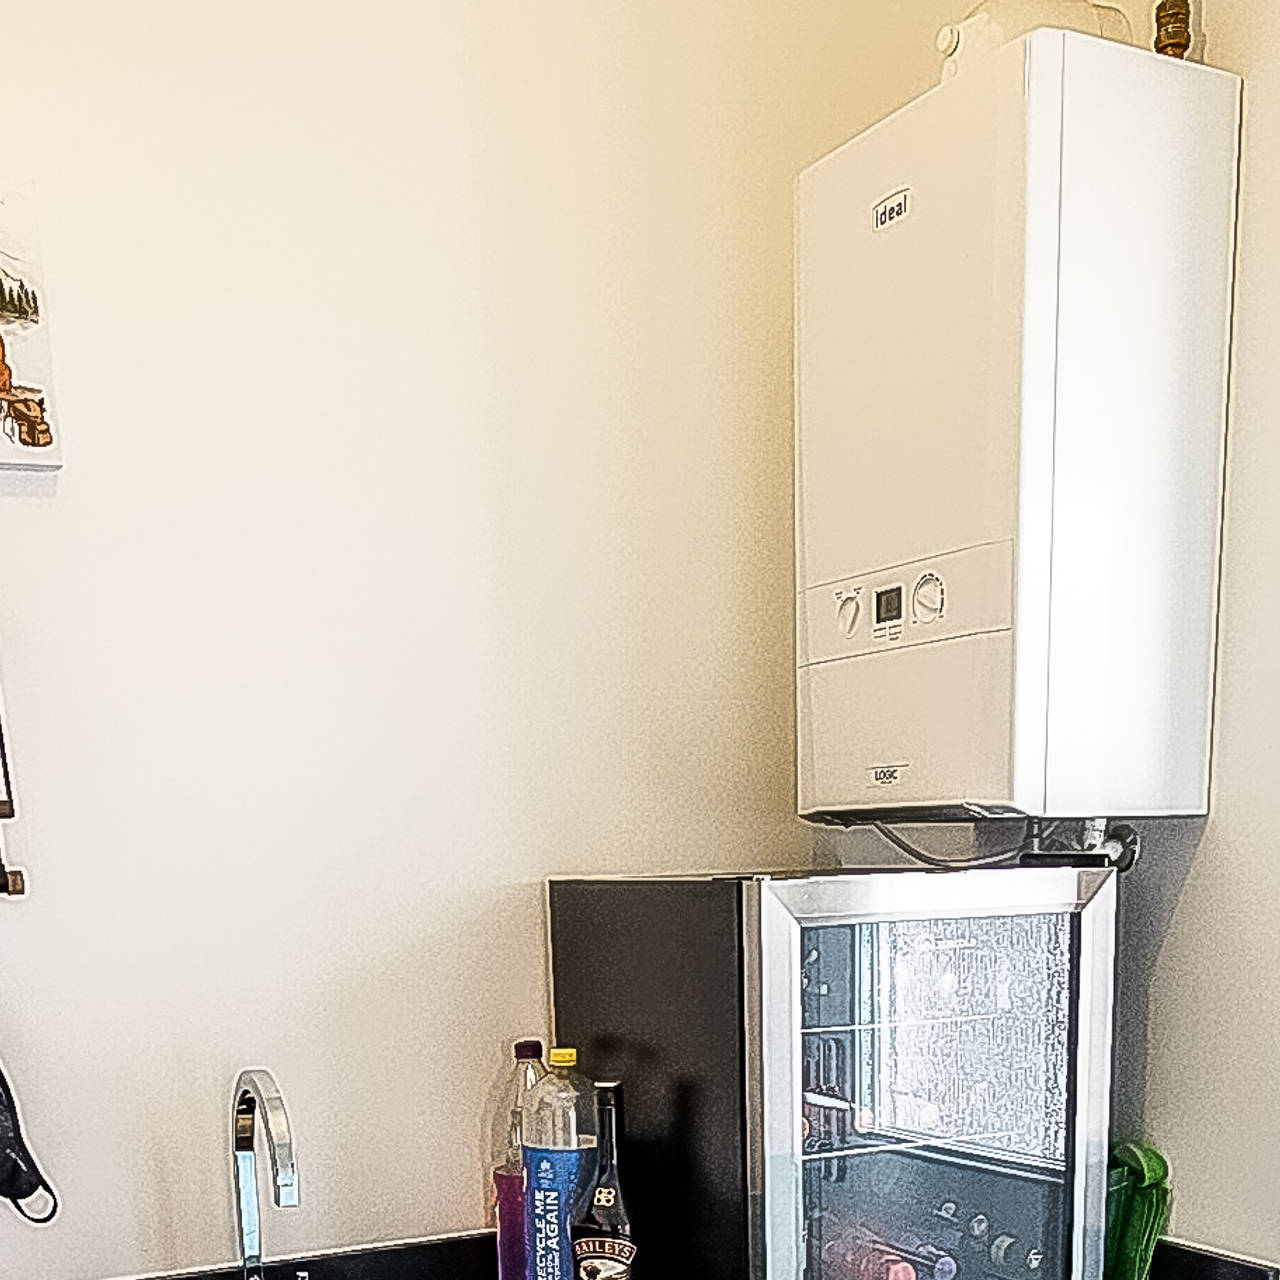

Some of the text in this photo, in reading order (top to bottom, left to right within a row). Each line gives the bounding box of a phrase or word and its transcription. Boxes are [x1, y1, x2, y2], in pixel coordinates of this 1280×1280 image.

[874, 768, 898, 781] LOGIC
[534, 1188, 546, 1216] ME
[545, 1191, 560, 1251] AGAIN
[575, 1240, 632, 1259] BAILEYS
